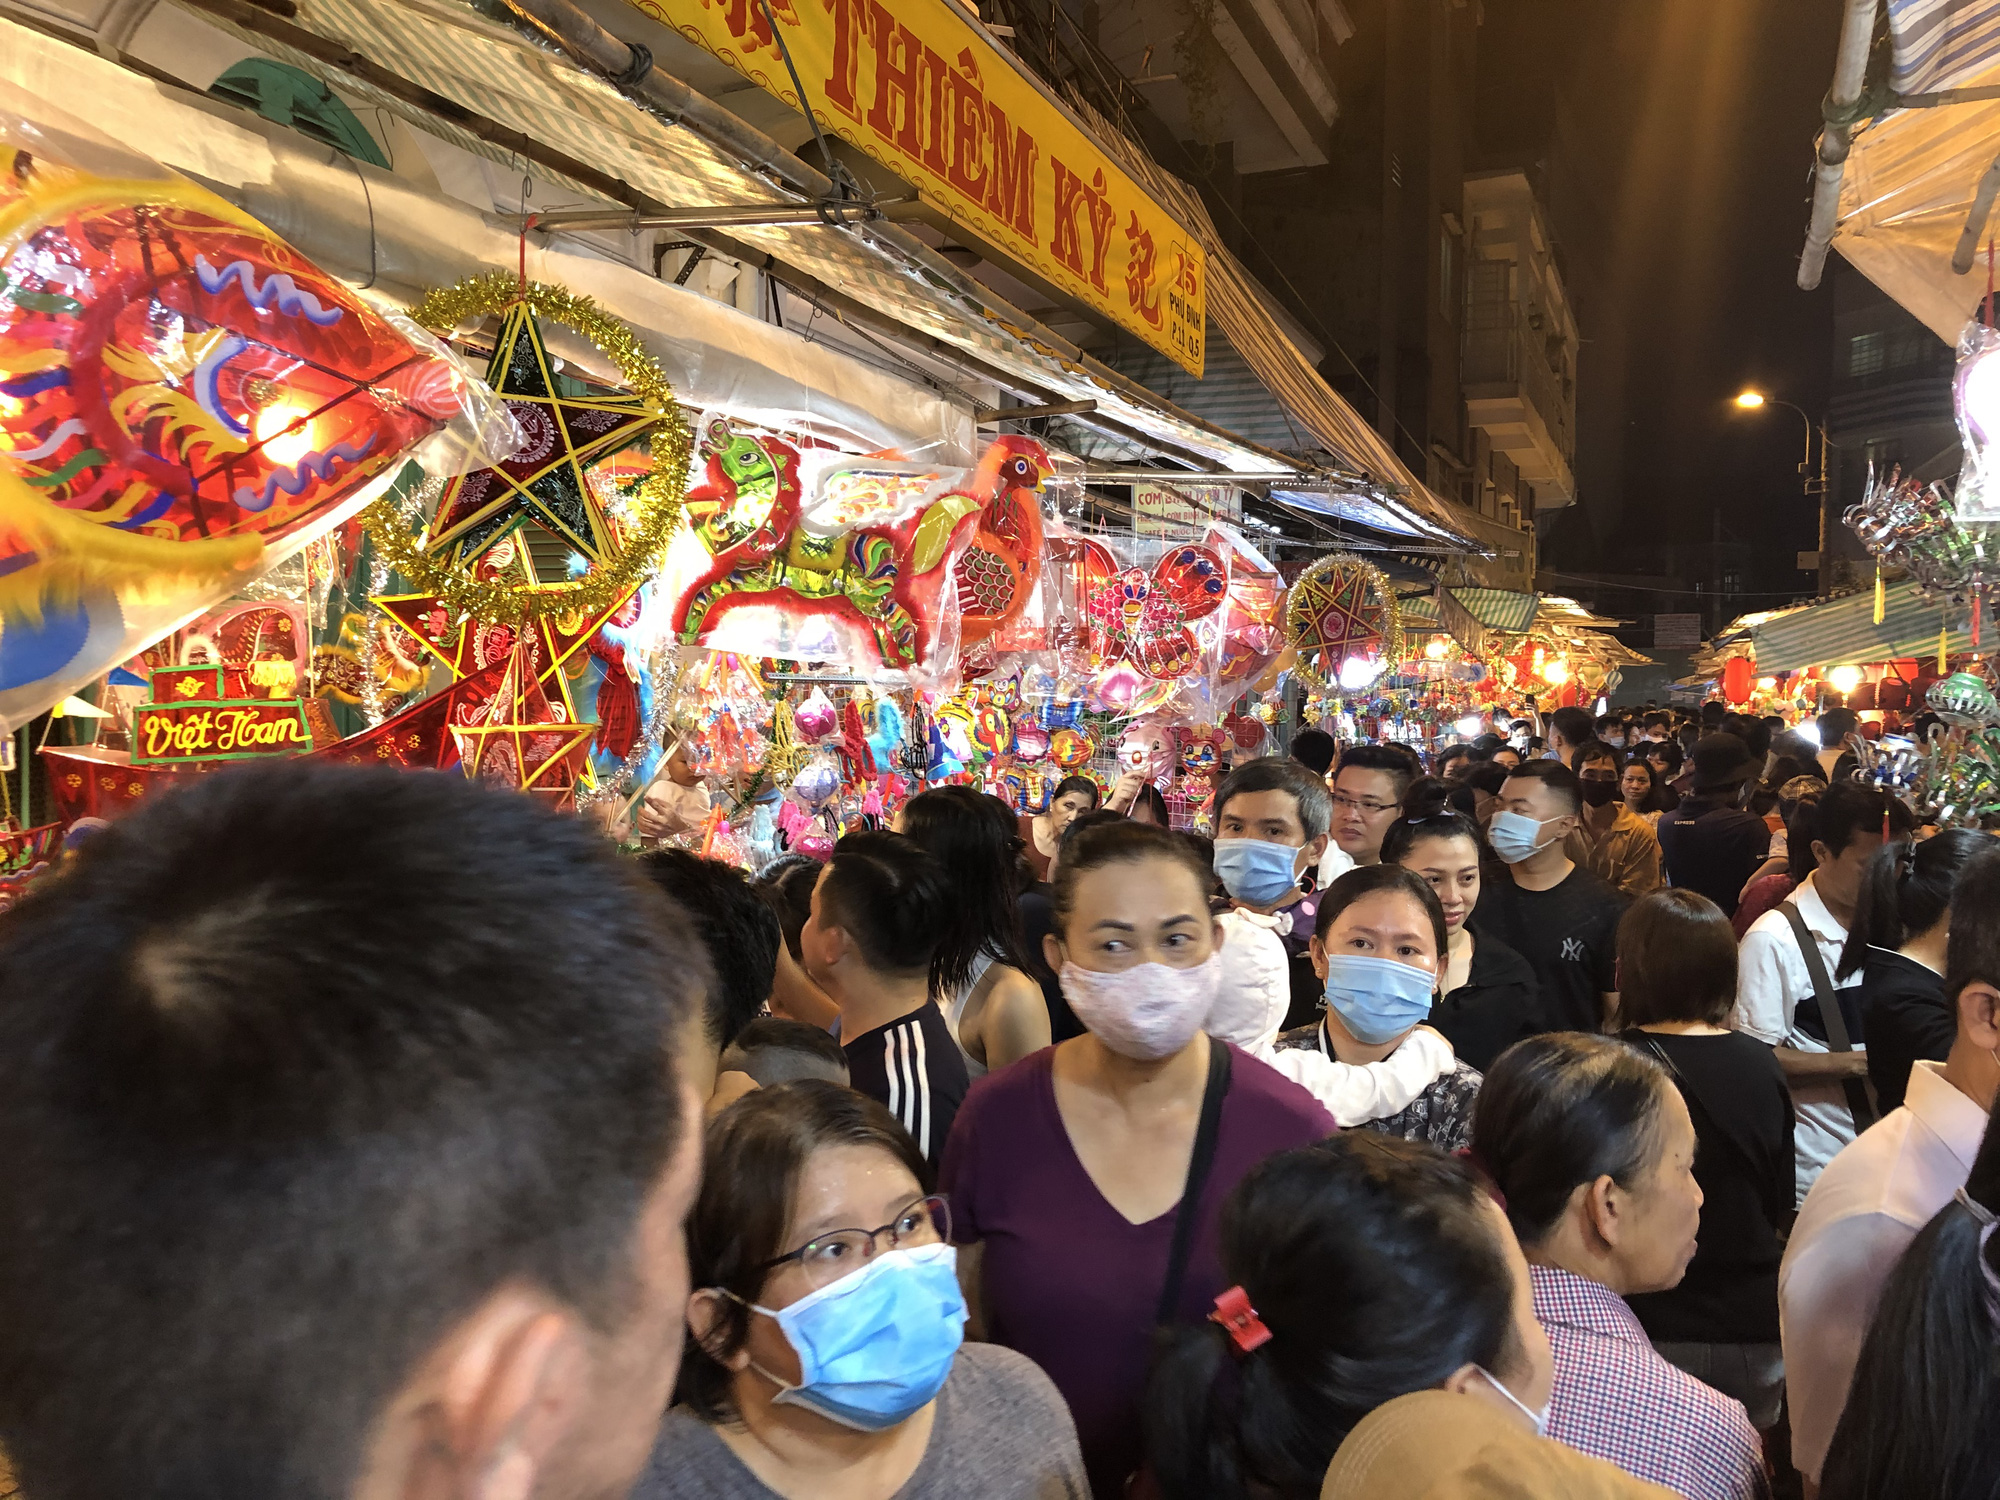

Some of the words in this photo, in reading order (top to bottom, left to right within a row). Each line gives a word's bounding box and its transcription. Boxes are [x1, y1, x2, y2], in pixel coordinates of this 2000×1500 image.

[824, 0, 1038, 248] THIÊM
[1176, 252, 1197, 297] 15
[1169, 291, 1185, 320] PHÚ
[1172, 321, 1186, 348] P.11
[144, 711, 213, 756] Việt
[215, 710, 313, 750] Nam
